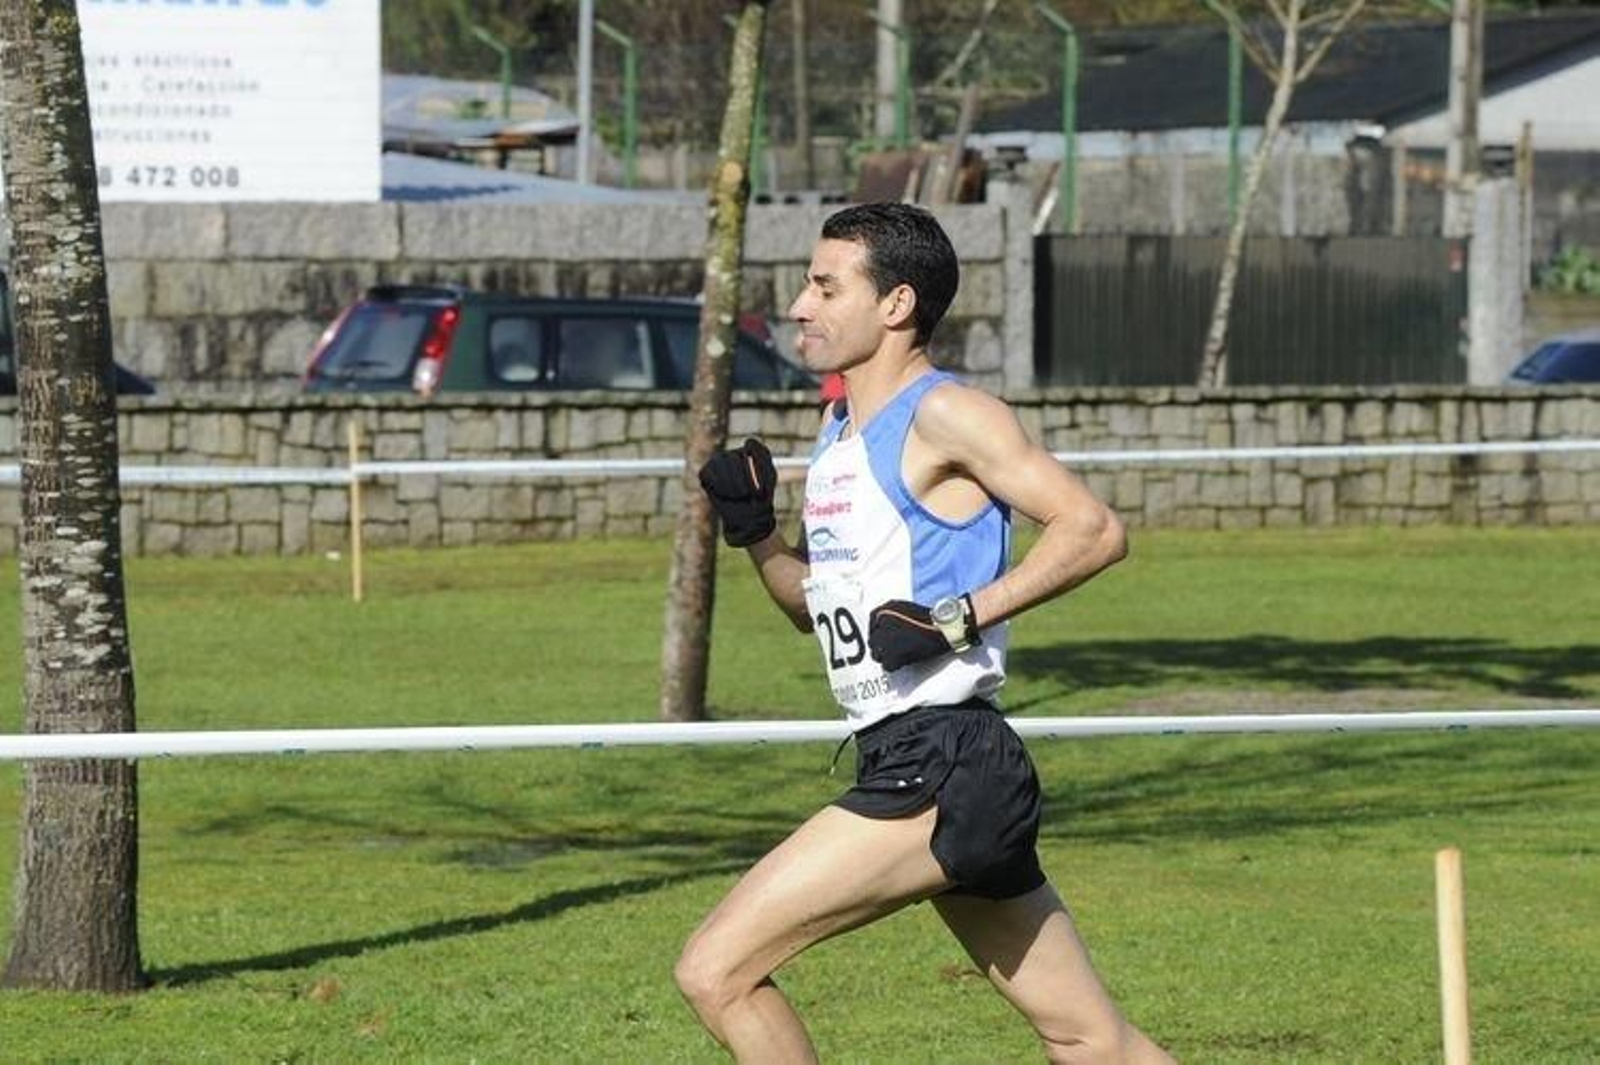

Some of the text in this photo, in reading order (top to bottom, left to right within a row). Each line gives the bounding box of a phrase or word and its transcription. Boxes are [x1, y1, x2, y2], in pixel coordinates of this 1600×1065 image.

[125, 166, 177, 188] 472
[190, 166, 241, 188] 008
[816, 607, 866, 670] 29
[859, 676, 889, 700] 2015
